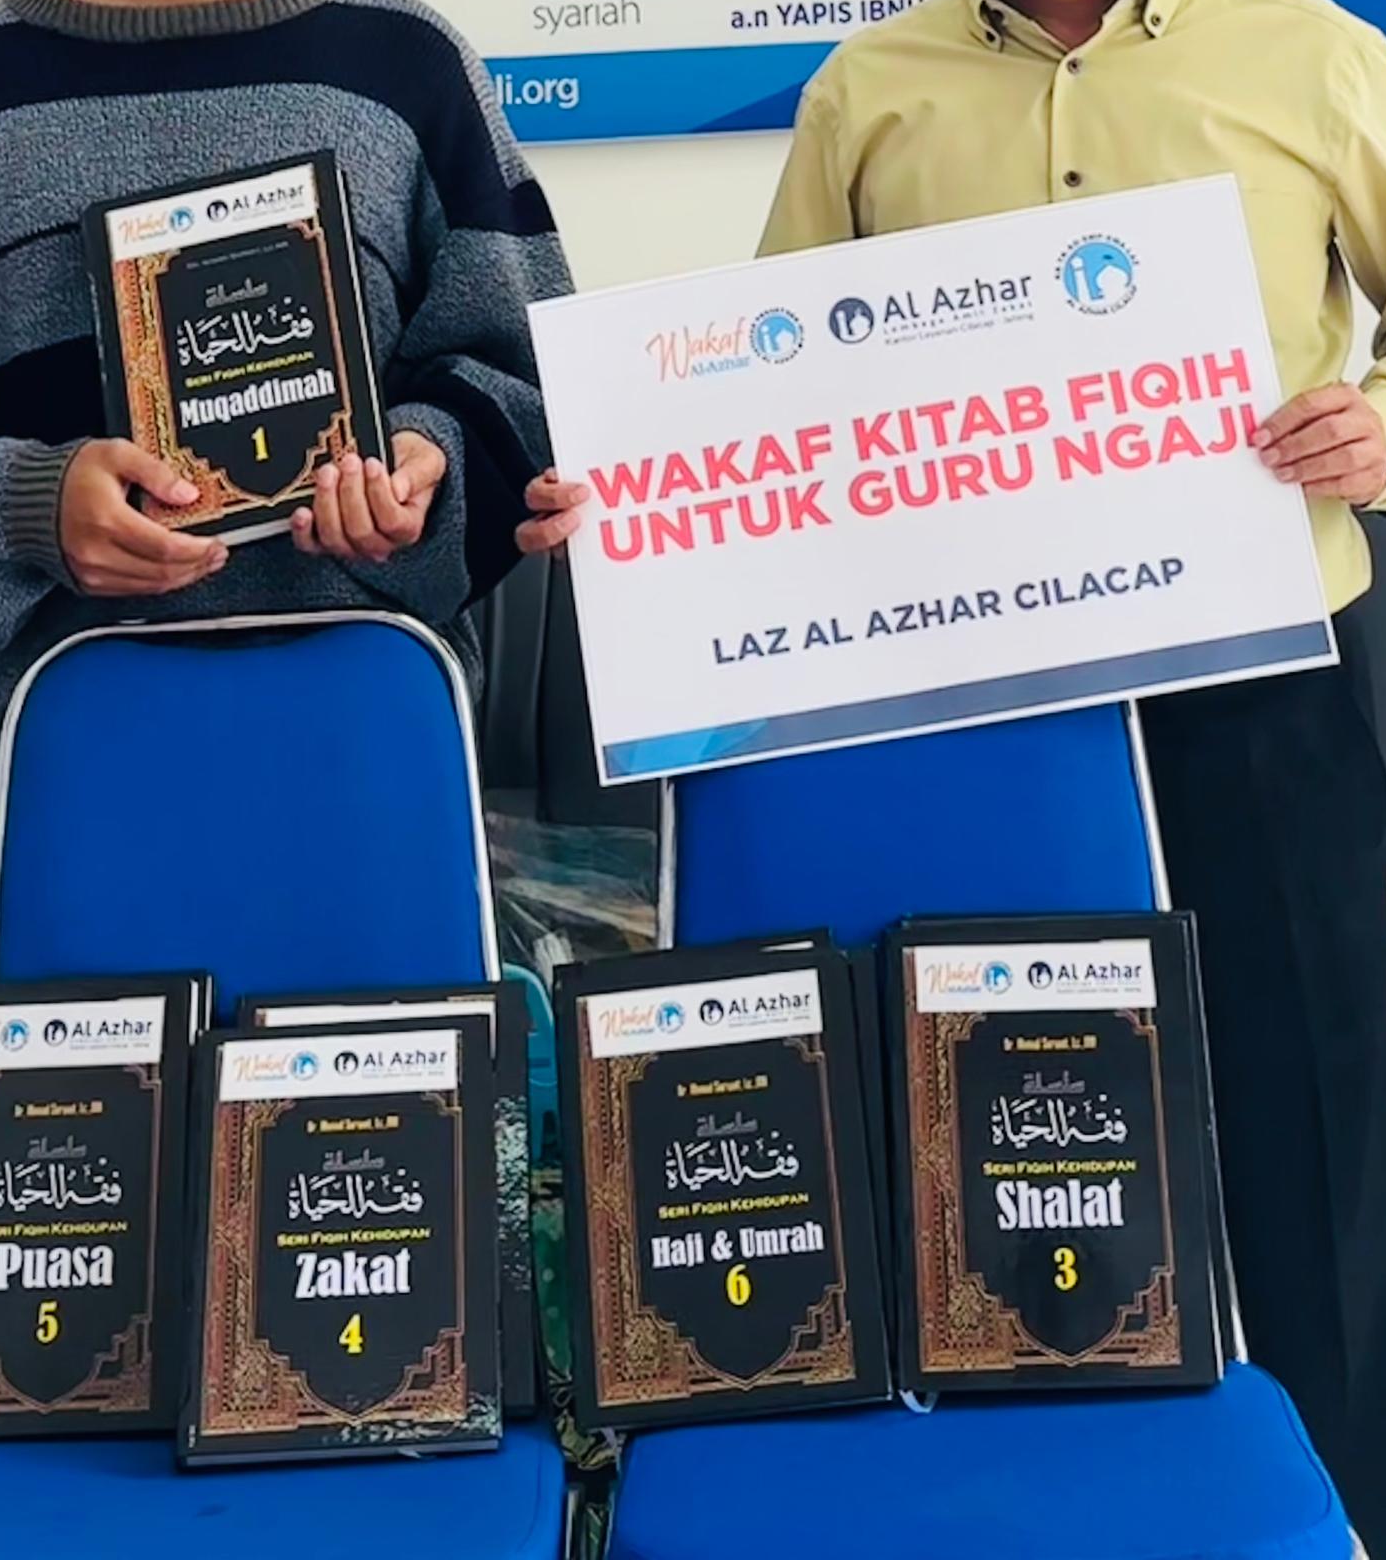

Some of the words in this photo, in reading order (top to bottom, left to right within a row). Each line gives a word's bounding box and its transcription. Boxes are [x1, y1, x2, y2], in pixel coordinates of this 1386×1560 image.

[730, 7, 768, 29] a.n
[776, 0, 853, 27] YAPIS
[232, 198, 250, 212] Al
[256, 184, 305, 205] Azhar
[645, 316, 746, 383] Wakaf
[884, 291, 920, 324] Al
[932, 276, 1032, 315] Azhar
[179, 368, 335, 428] Muqaddimah
[251, 426, 269, 462] 1
[588, 424, 833, 509] WAKAF
[852, 385, 1051, 461] KITAB
[1067, 347, 1253, 422] FIQIH
[599, 481, 833, 562] UNTUK
[848, 442, 1034, 517] GURU
[1053, 403, 1260, 481] NGAJI
[712, 625, 791, 665] LAZ
[802, 617, 854, 649] AL
[865, 589, 1003, 639] AZHAR
[1013, 557, 1186, 612] CILACAP
[1058, 964, 1078, 980] Al
[1085, 962, 1142, 979] Azhar
[729, 998, 748, 1015] Al
[755, 992, 811, 1011] Azhar
[72, 1021, 91, 1037] Al
[98, 1018, 153, 1036] Azhar
[364, 1051, 383, 1067] Al
[391, 1049, 447, 1064] Azhar
[995, 1176, 1125, 1230] Shalat
[651, 1232, 705, 1269] Haji
[710, 1229, 733, 1261] &
[739, 1220, 825, 1258] Umrah
[295, 1247, 411, 1298] Zakat
[726, 1263, 751, 1306] 6
[1054, 1247, 1078, 1291] 3
[36, 1301, 59, 1343] 5
[338, 1313, 363, 1354] 4
